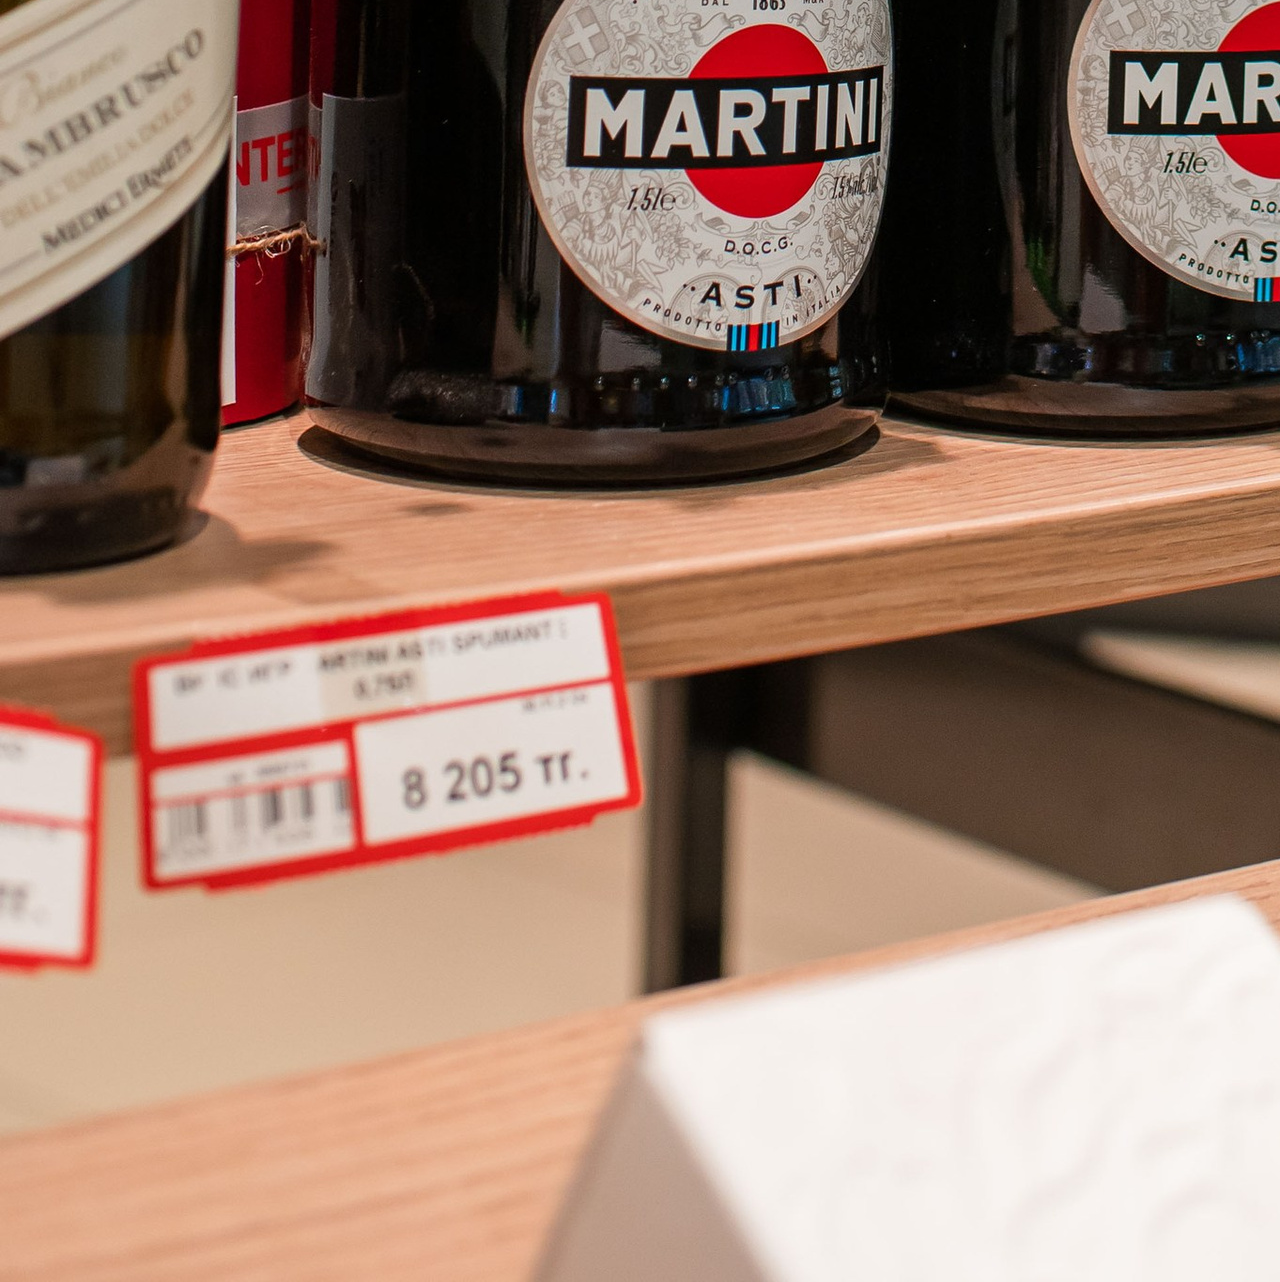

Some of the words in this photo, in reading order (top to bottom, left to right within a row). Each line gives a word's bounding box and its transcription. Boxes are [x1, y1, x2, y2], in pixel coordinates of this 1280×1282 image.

[582, 77, 877, 159] MARTINI
[41, 186, 127, 256] MEDICI
[1178, 252, 1250, 285] PRODOTTO
[700, 275, 804, 311] ASTI
[785, 312, 800, 328] IN
[805, 285, 842, 320] ITALIA
[643, 297, 723, 333] PRODOTTO
[401, 766, 427, 810] 8
[444, 753, 522, 803] 205
